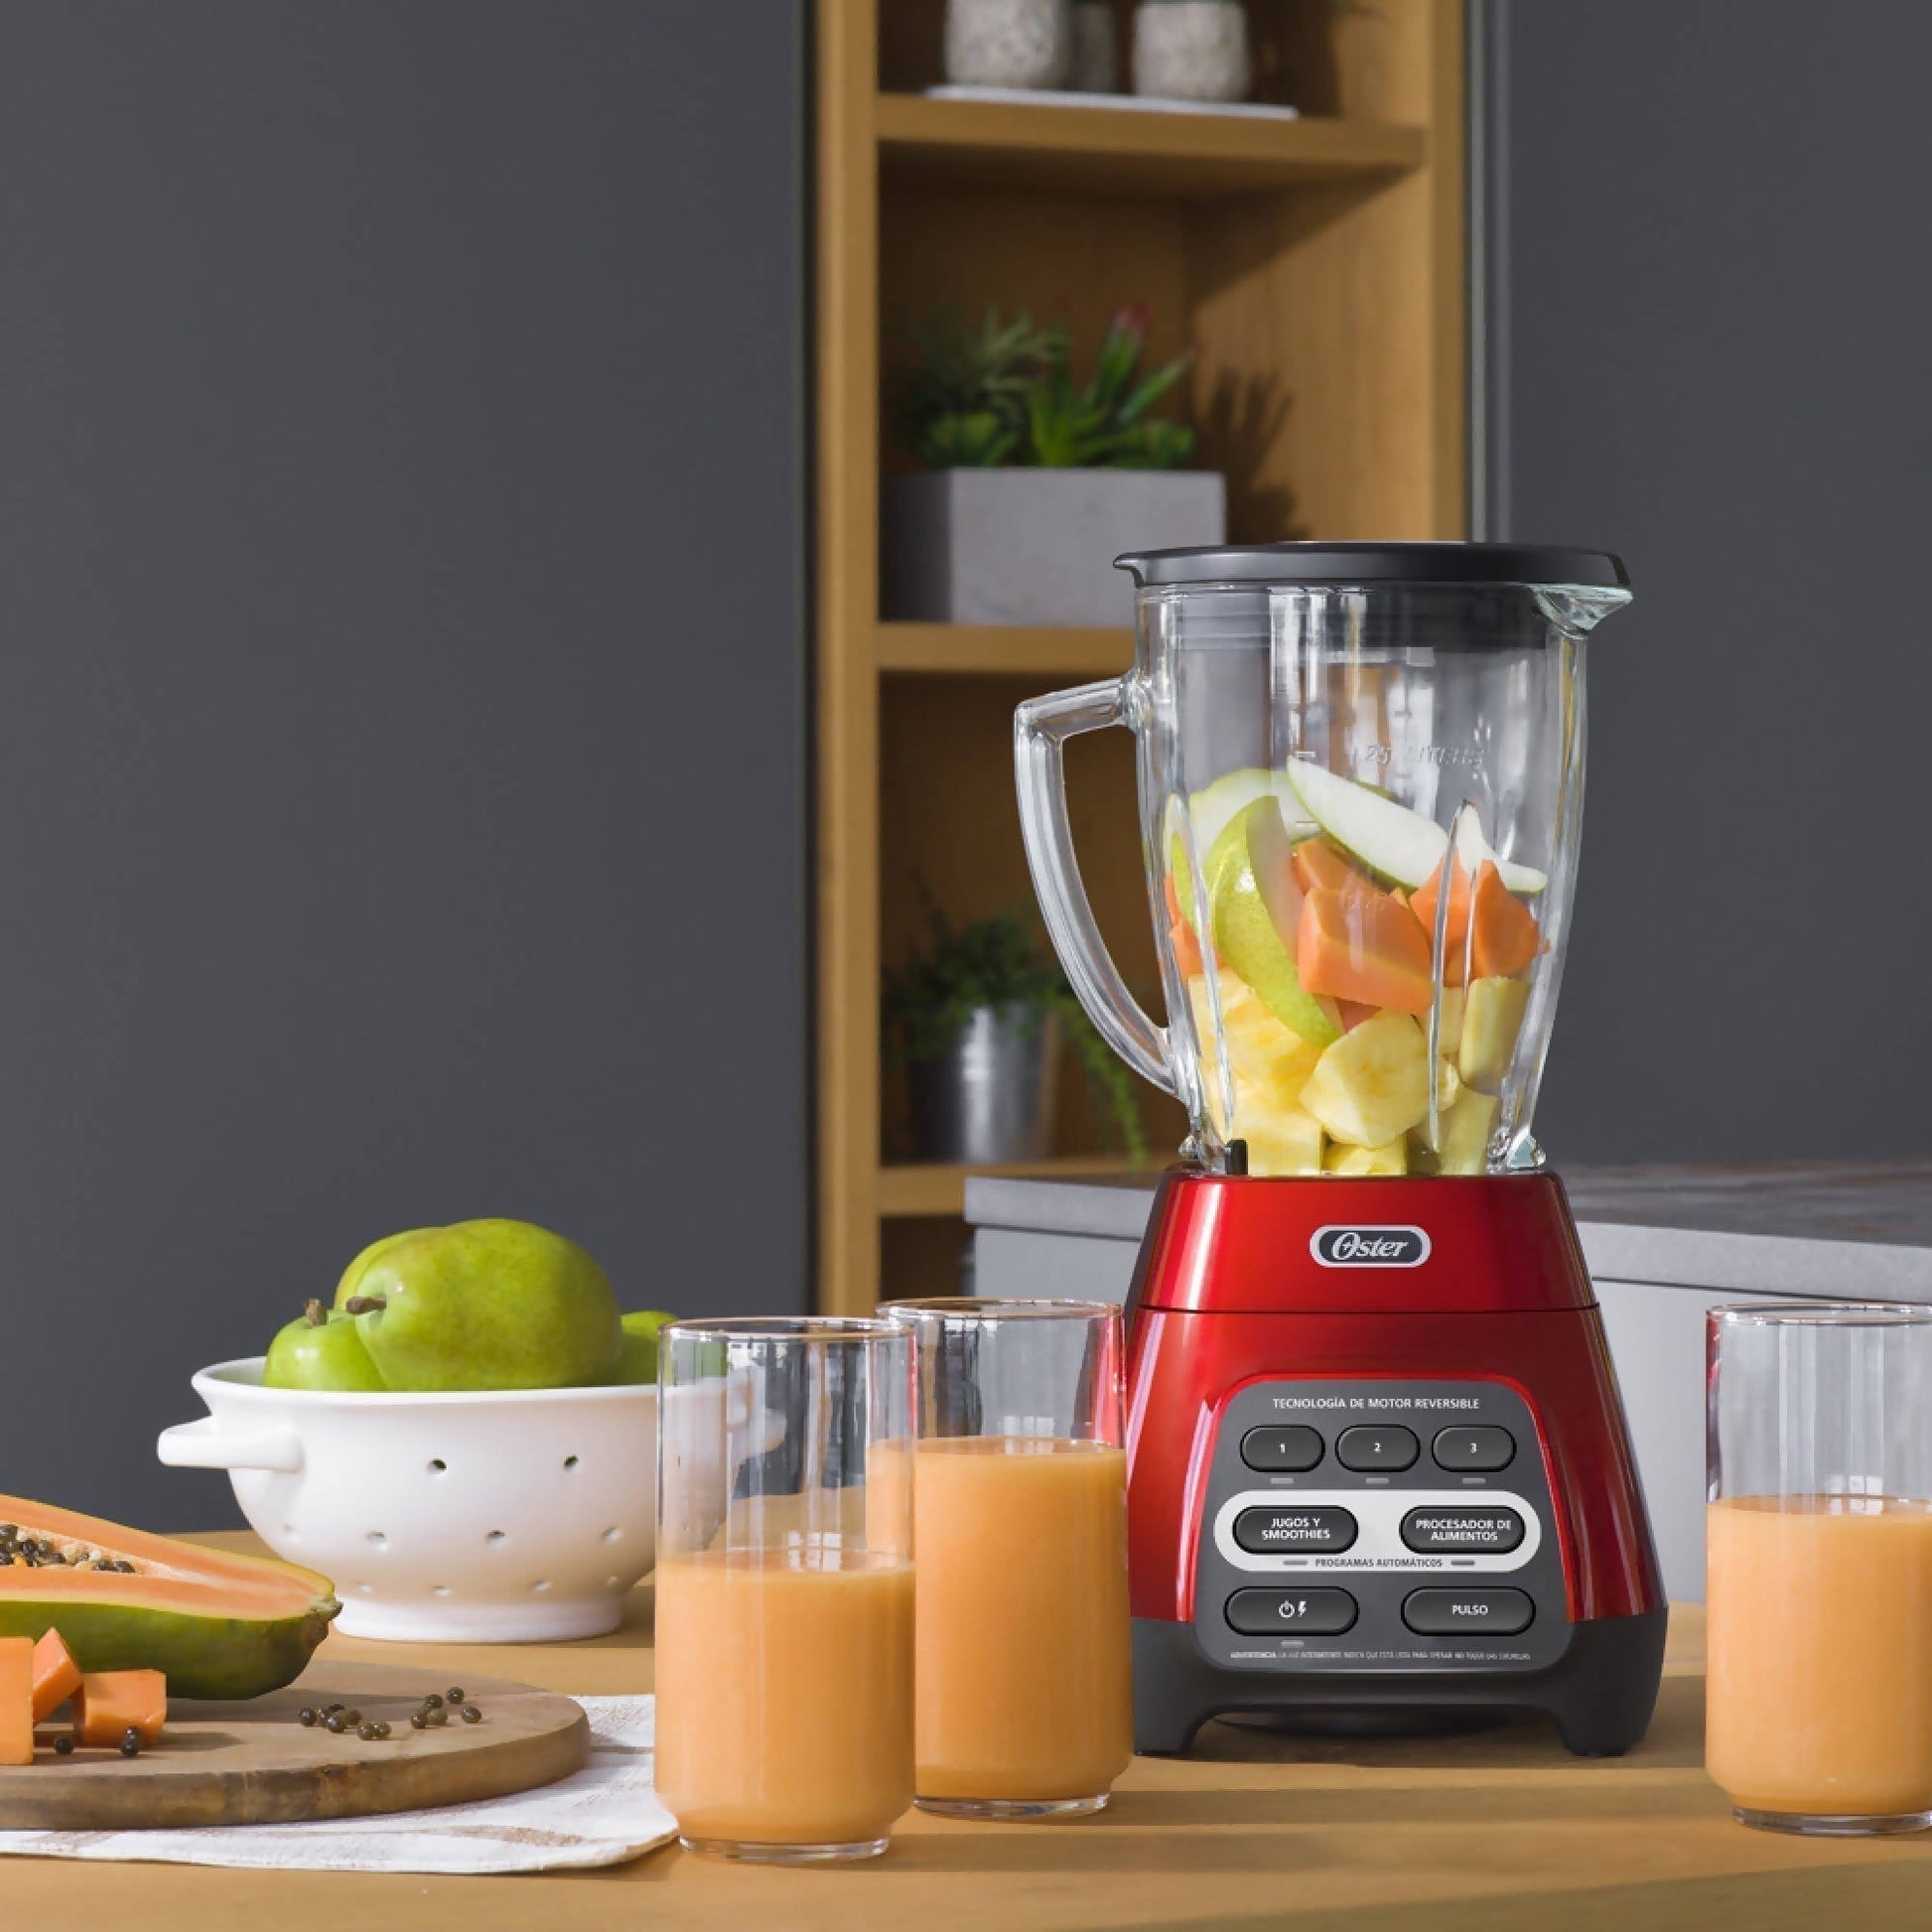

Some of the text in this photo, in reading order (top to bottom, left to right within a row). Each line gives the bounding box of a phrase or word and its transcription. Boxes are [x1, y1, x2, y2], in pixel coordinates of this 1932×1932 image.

[1332, 1232, 1409, 1261] Oster
[1273, 1396, 1480, 1409] TECNOLOGÍA DE MOTOR REVERSIBLE
[1279, 1443, 1286, 1453] 1
[1374, 1443, 1383, 1453] 2
[1469, 1443, 1477, 1453] 3
[1271, 1517, 1320, 1529] JUGOS Y
[1416, 1519, 1512, 1530] PROCESADOR DE
[1261, 1528, 1330, 1540] SMOOTHIES
[1431, 1531, 1498, 1542] ALIMENTOS
[1314, 1556, 1444, 1568] PROGRAMAS AUTOMÁTICOS
[1451, 1604, 1488, 1615] PULSO
